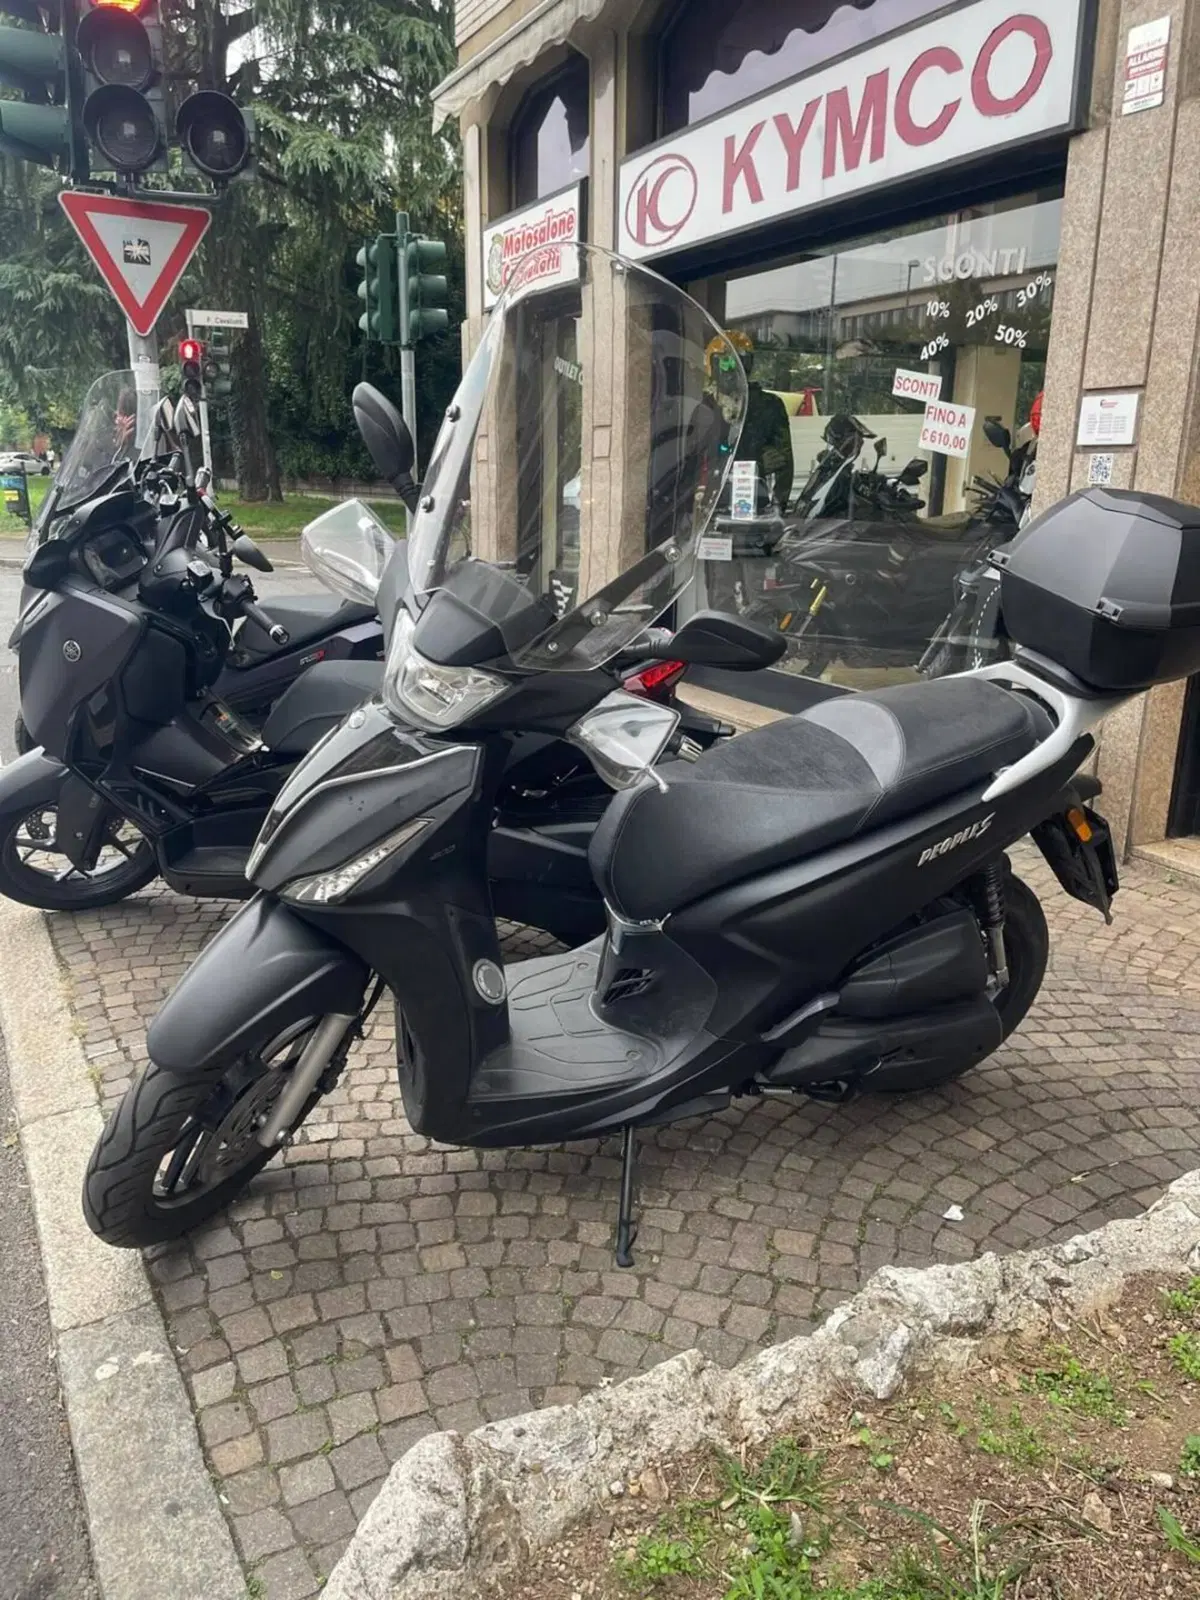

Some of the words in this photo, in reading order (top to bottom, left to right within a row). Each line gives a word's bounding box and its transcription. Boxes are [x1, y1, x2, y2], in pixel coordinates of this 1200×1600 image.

[722, 13, 1053, 215] KYMCO
[502, 211, 575, 258] Motosalone
[923, 248, 1026, 282] SCONTI
[926, 301, 950, 318] 10%
[966, 296, 998, 328] 20%
[1016, 271, 1052, 307] 30%
[920, 332, 950, 360] 40%
[994, 324, 1028, 348] 50%
[894, 376, 939, 398] SCONTI
[926, 405, 956, 425] FINO
[958, 413, 967, 428] A
